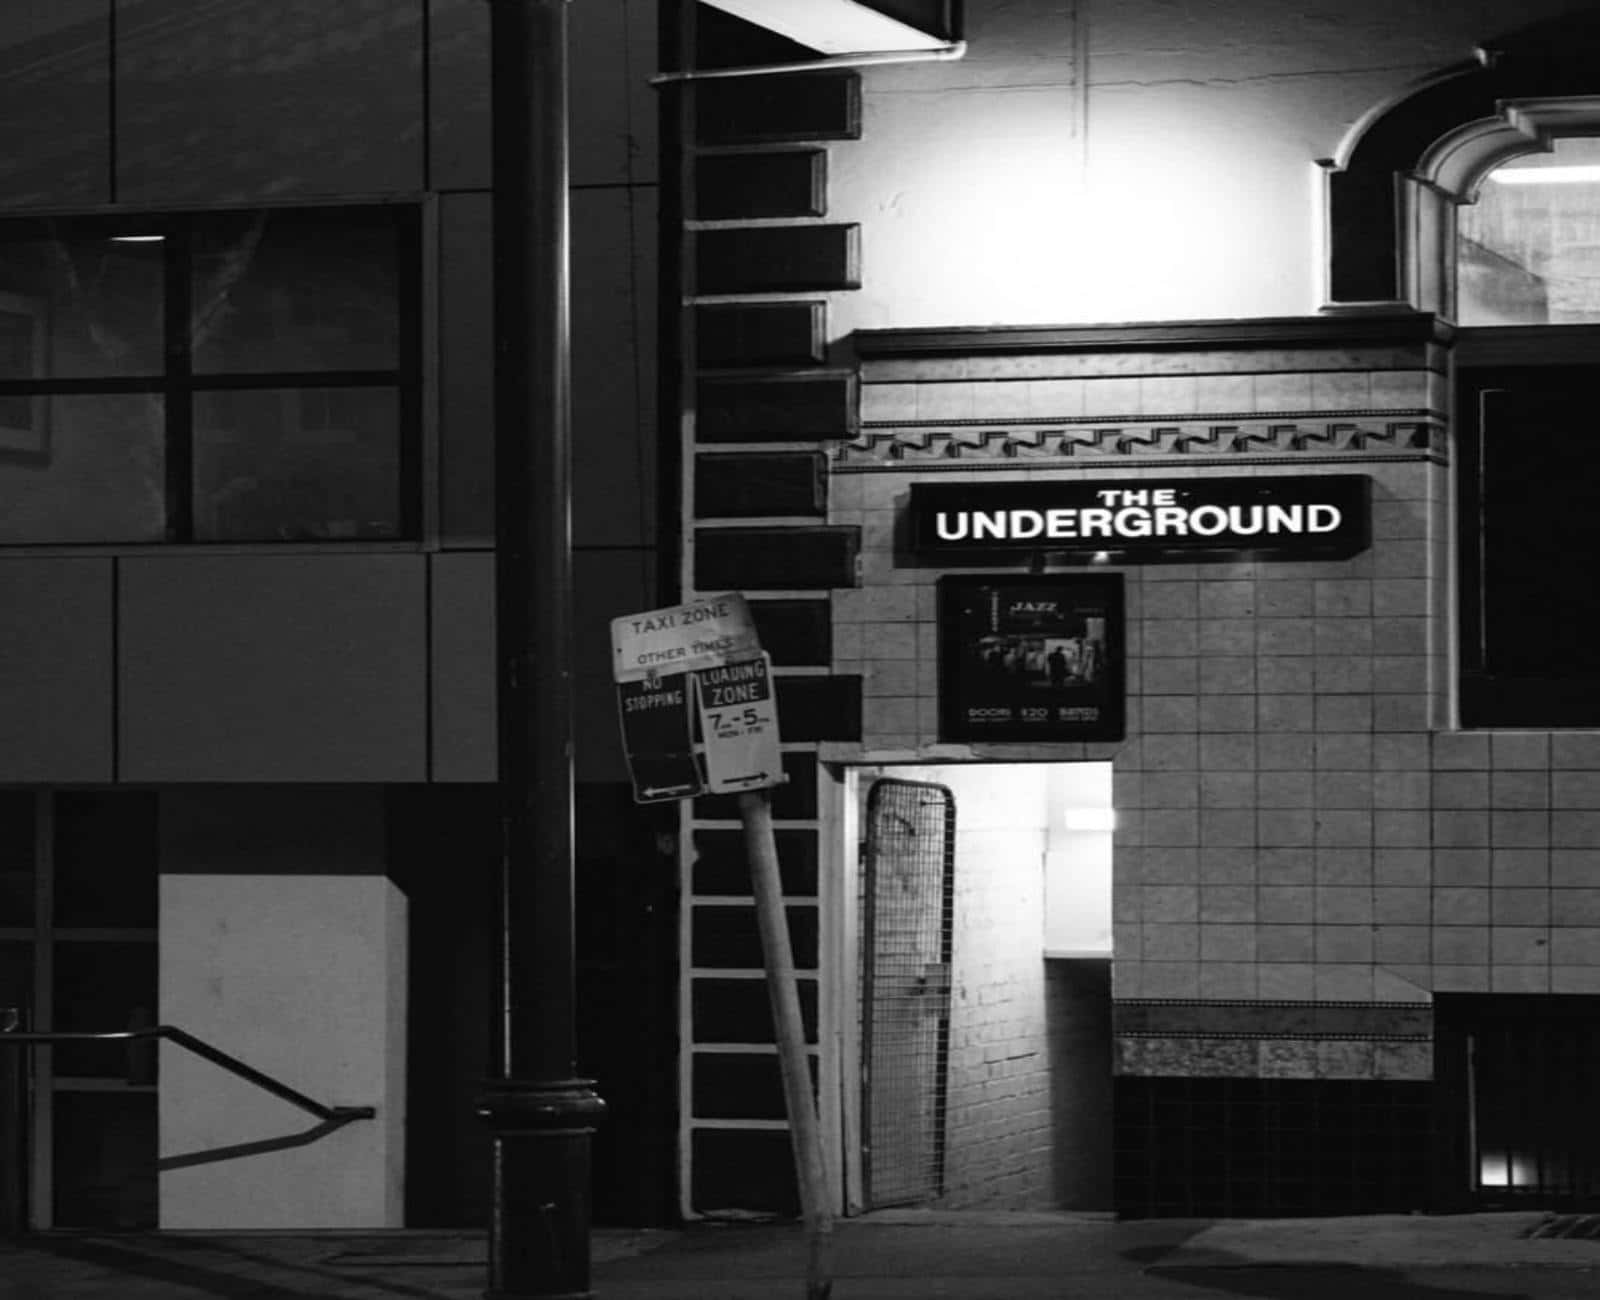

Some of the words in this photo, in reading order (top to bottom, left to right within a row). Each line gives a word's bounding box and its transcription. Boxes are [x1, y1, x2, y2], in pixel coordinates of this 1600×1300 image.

[1097, 488, 1177, 507] THE
[936, 504, 1341, 541] UNDERGROUND
[632, 616, 675, 634] TAXI
[681, 603, 729, 625] ZONE
[1010, 602, 1057, 612] JAZZ
[638, 648, 686, 665] OTHER
[692, 637, 736, 654] TIMES
[702, 661, 764, 685] LOADING
[624, 691, 683, 712] STOPPING
[712, 683, 759, 705] ZONE
